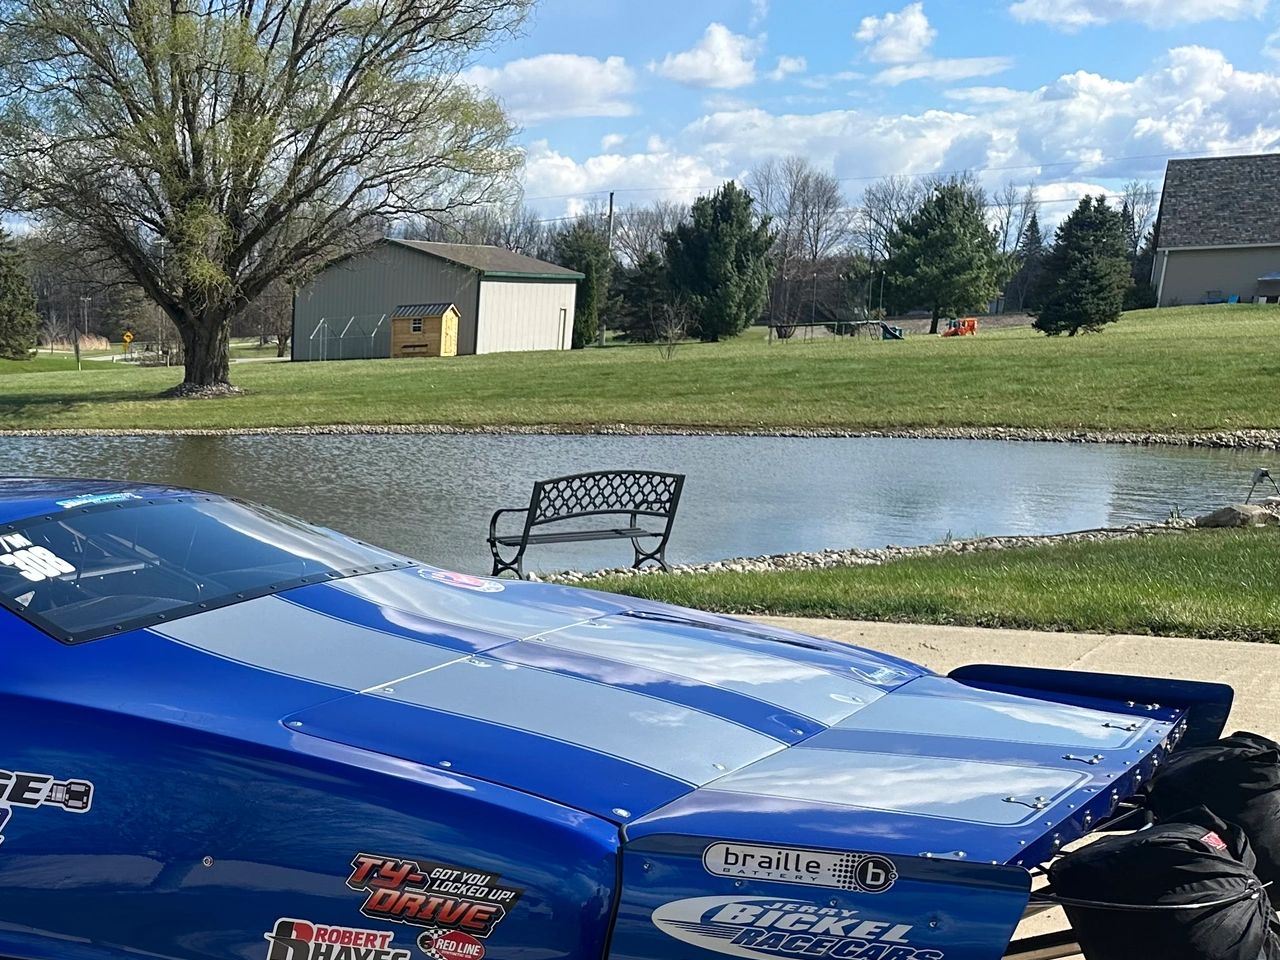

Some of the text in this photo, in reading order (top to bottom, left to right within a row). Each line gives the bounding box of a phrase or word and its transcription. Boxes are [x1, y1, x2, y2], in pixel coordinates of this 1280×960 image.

[723, 847, 821, 875] braille
[430, 868, 490, 886] GOT YOU
[722, 868, 819, 882] BATTERY
[432, 880, 515, 903] LOCKED UP!
[366, 888, 498, 929] DRIVE
[763, 901, 860, 918] JERRY
[710, 903, 915, 944] BICKEL
[314, 927, 392, 950] ROBERT
[435, 939, 481, 956] RED LINE
